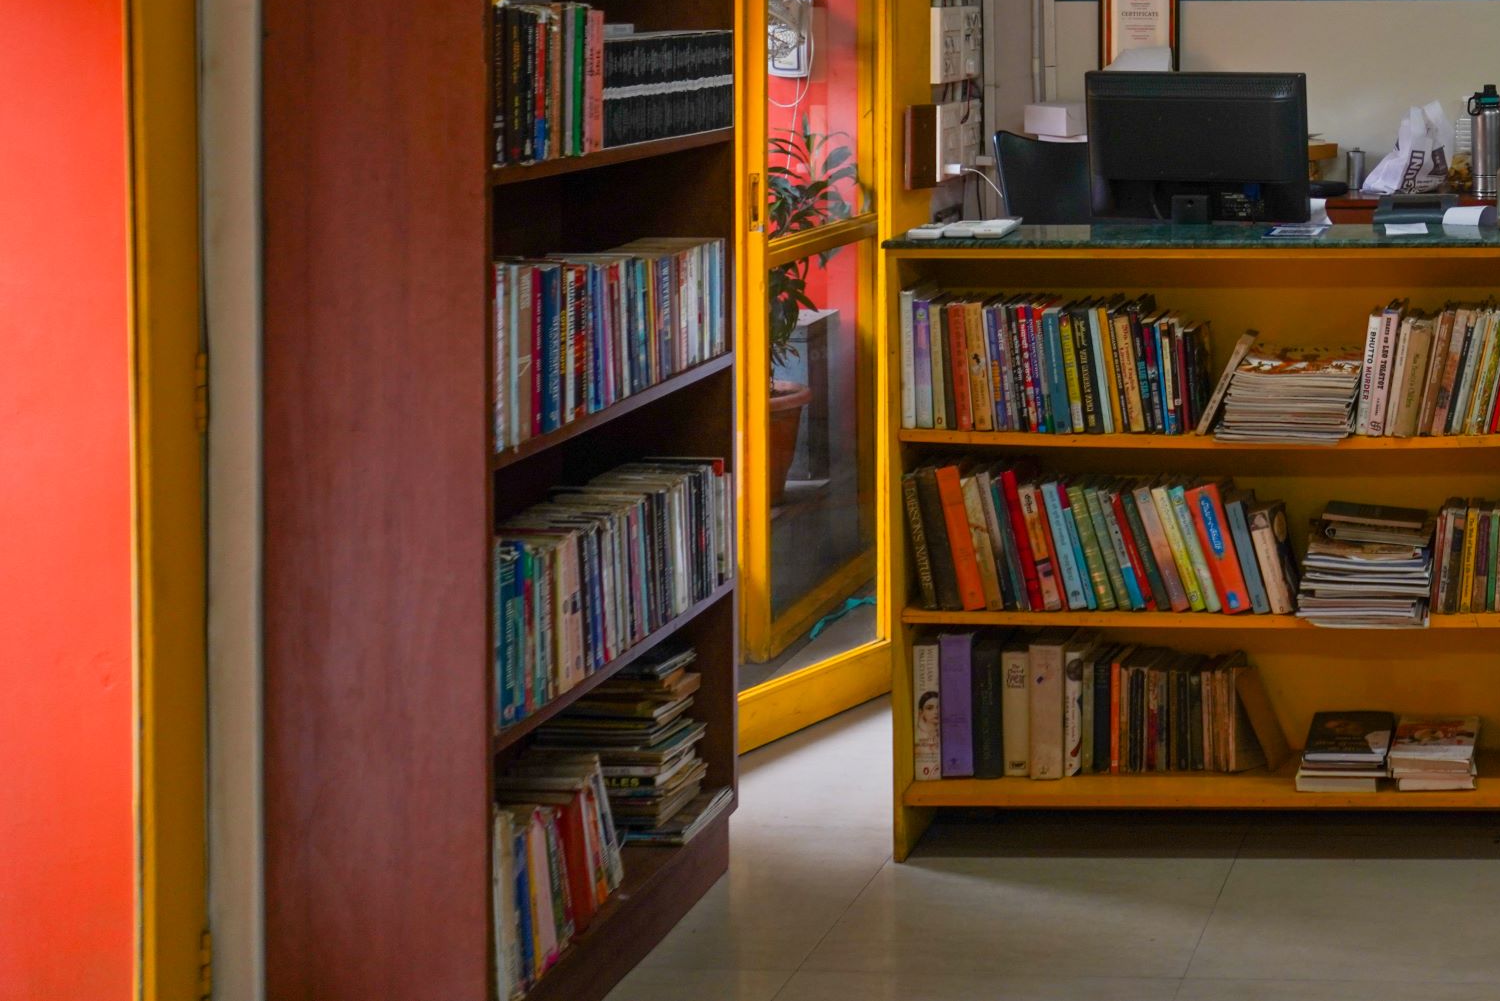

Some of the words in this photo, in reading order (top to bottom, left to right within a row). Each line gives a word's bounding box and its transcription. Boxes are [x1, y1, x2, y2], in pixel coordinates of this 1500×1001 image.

[1031, 342, 1039, 378] EDUCATION
[1120, 324, 1128, 340] 20th
[1127, 367, 1135, 391] English
[1367, 331, 1376, 364] BHUTTO
[1381, 345, 1389, 358] LEO
[1137, 360, 1147, 379] BLUE
[1362, 366, 1372, 400] MURDER
[1377, 360, 1387, 390] TOLSTOY
[1140, 380, 1150, 399] STAR
[905, 487, 924, 542] EMERSON'S
[914, 544, 932, 590] NATURE
[604, 776, 640, 787] ALES
